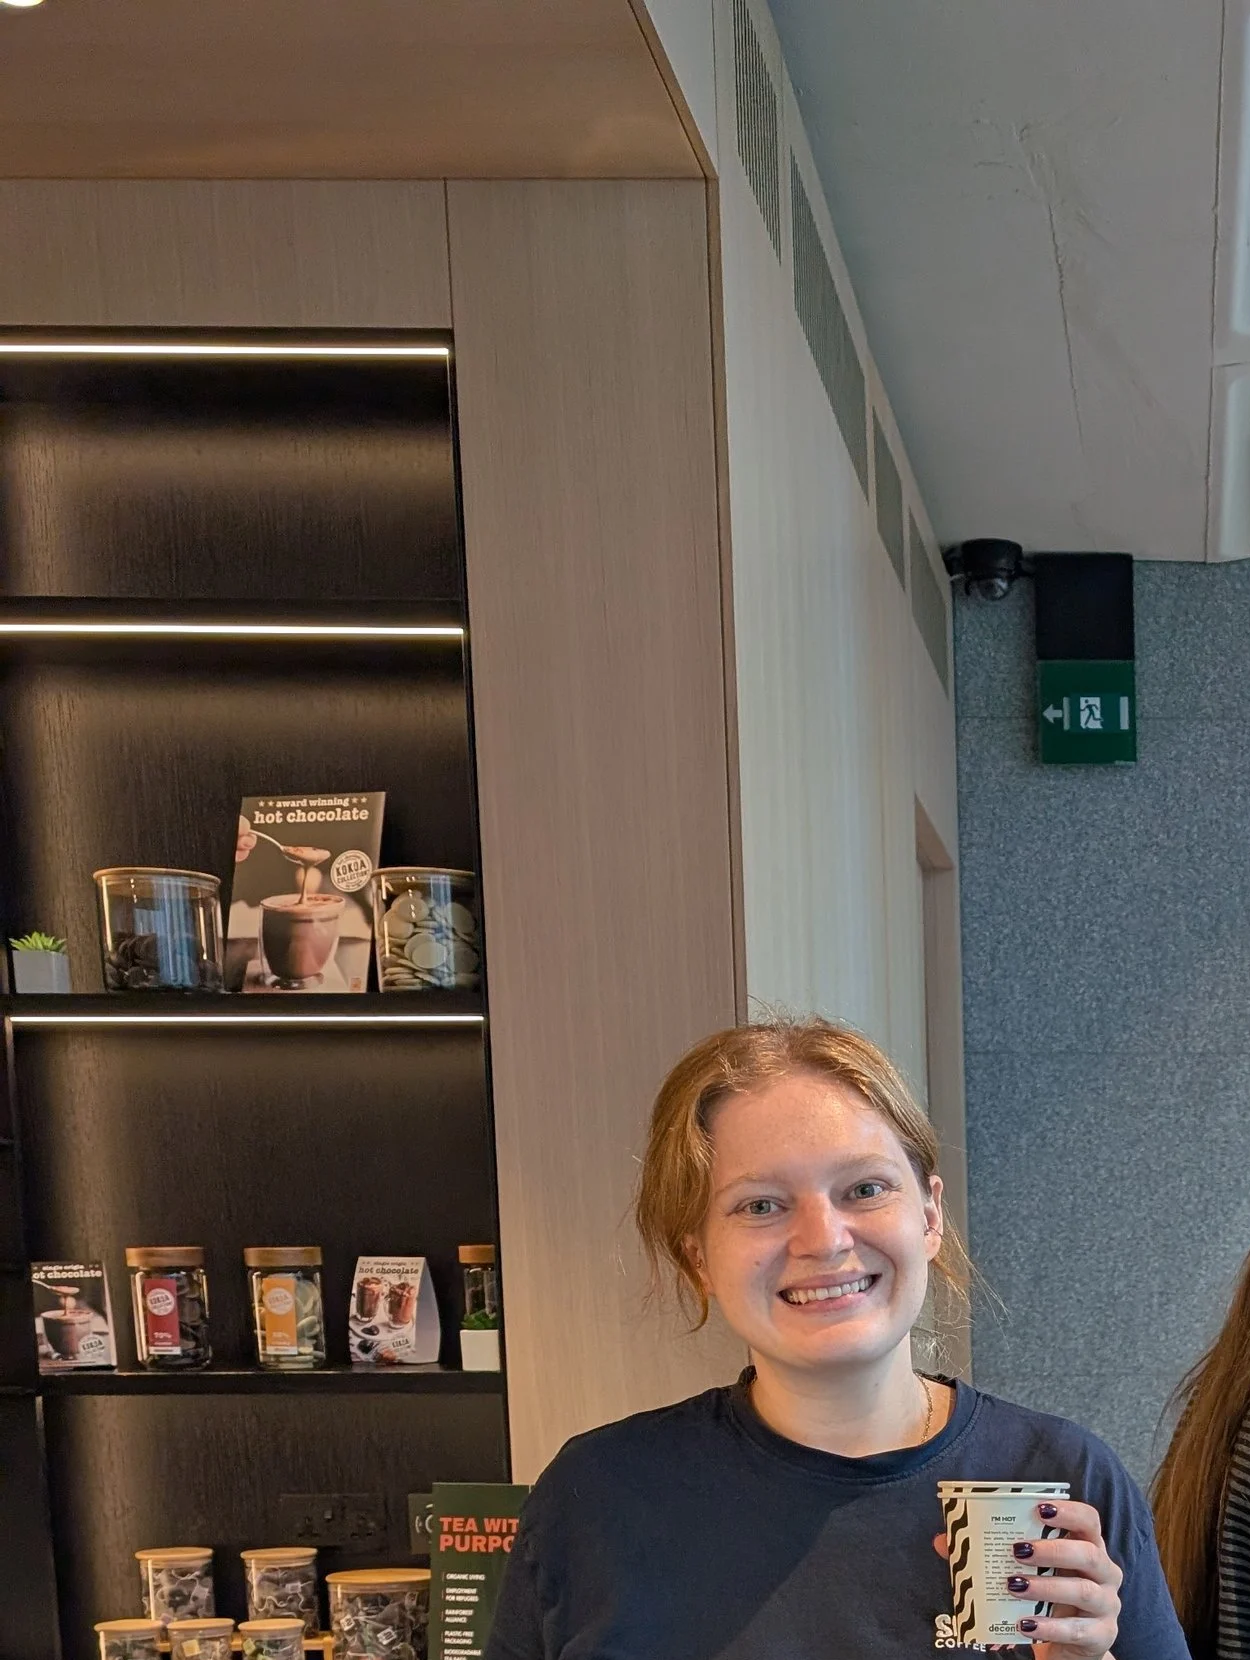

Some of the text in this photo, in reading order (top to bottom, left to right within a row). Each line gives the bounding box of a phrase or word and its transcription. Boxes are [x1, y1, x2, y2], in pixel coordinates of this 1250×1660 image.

[276, 797, 349, 808] award winning
[253, 808, 369, 824] hot chocolate
[335, 859, 367, 877] KOKOA
[48, 1269, 102, 1279] chocolate
[376, 1267, 419, 1275] chocolate
[439, 1517, 519, 1533] TEA WIT
[440, 1534, 515, 1553] PURPO
[989, 1624, 1020, 1633] decent
